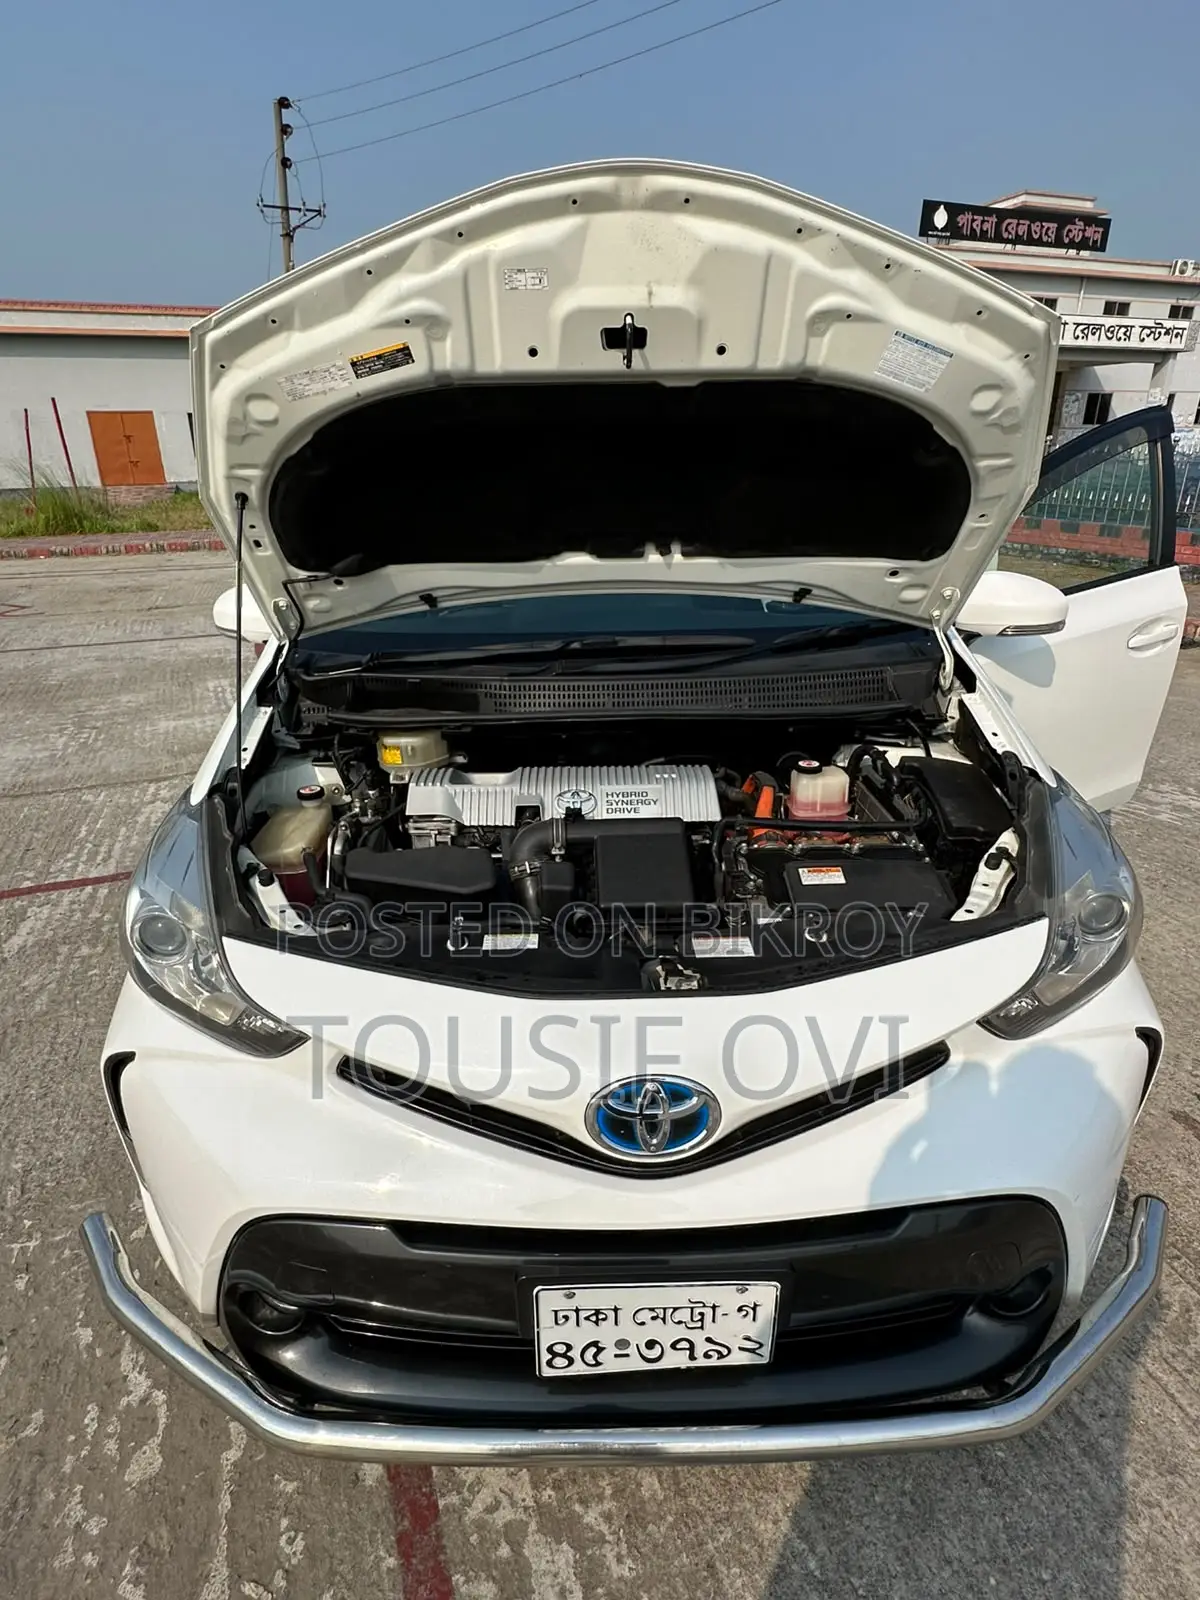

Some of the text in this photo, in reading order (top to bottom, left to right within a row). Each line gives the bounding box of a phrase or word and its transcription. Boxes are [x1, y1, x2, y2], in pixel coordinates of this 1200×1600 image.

[957, 211, 1104, 247] পাবনা রেলওয়ে স্টেশন
[1073, 322, 1134, 342] রেলওয়ে
[1138, 320, 1186, 344] স্টেশন
[605, 798, 659, 806] SYNERGY
[605, 806, 641, 814] DRIVE
[551, 1304, 622, 1328] ঢাকা
